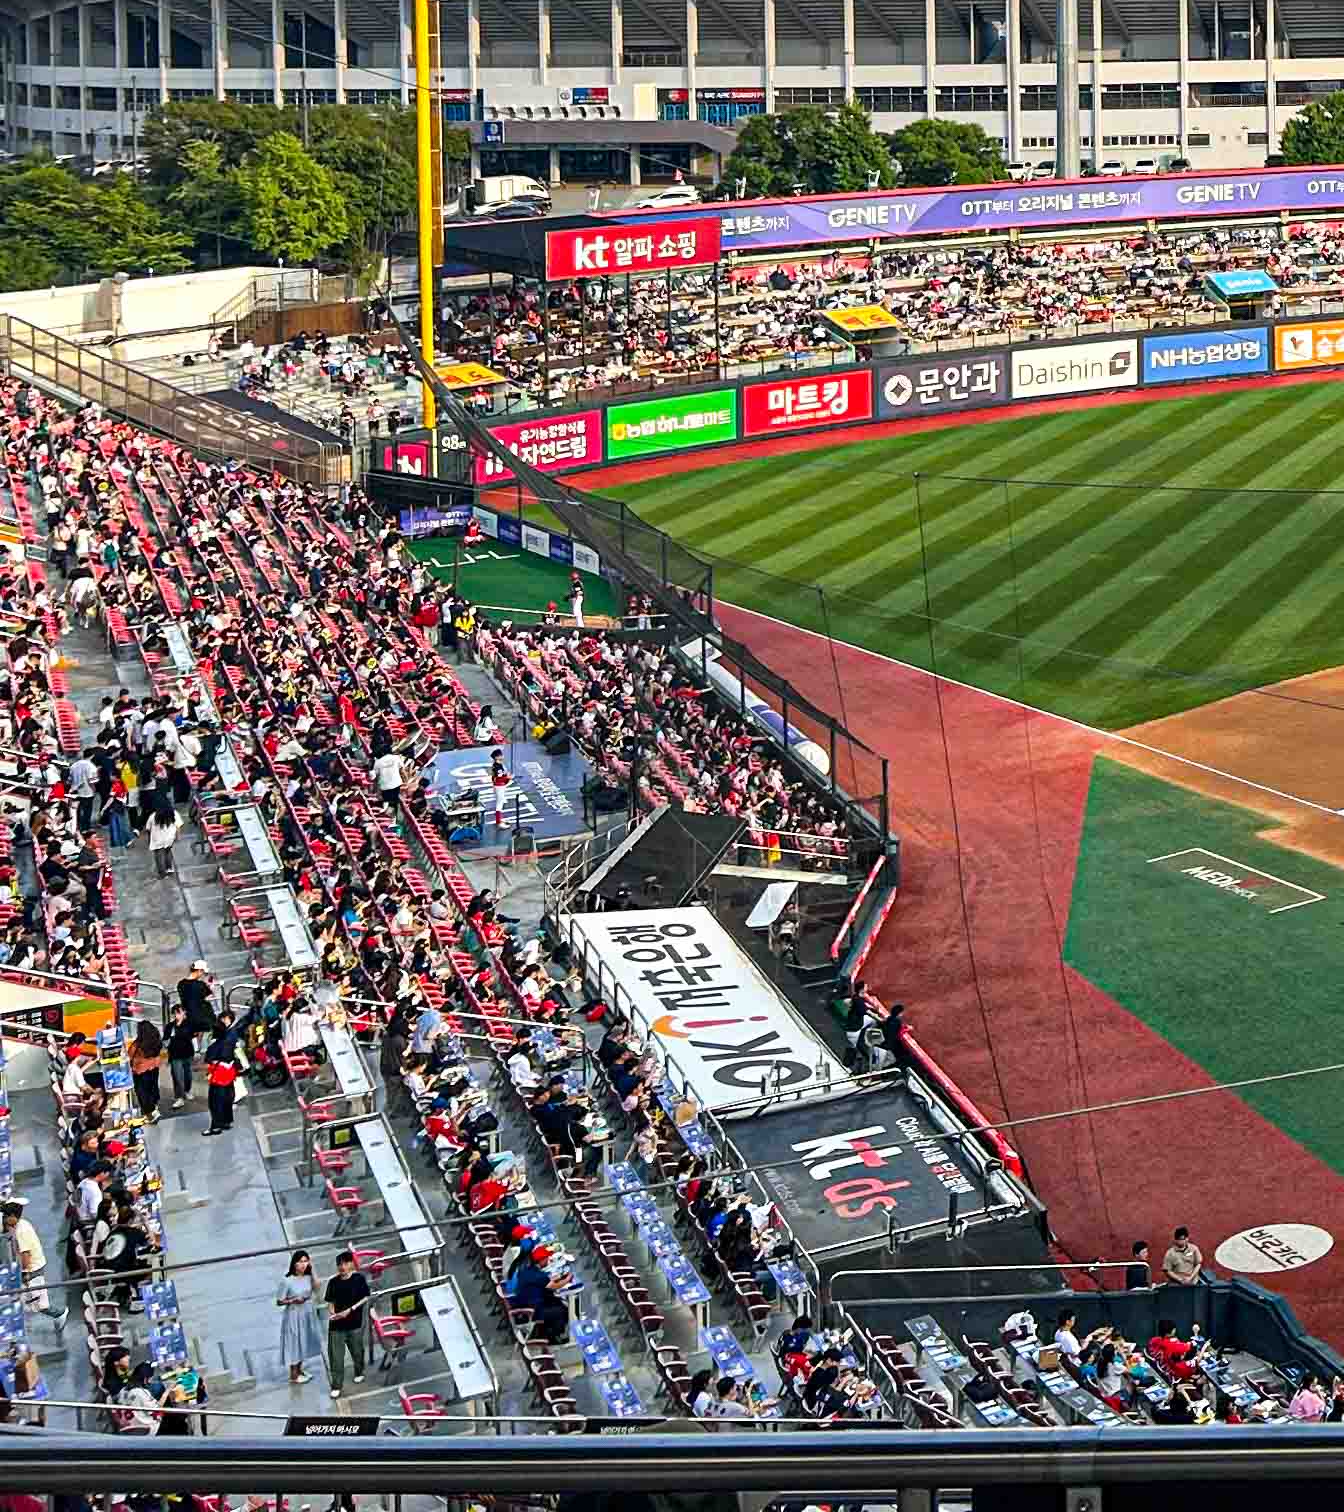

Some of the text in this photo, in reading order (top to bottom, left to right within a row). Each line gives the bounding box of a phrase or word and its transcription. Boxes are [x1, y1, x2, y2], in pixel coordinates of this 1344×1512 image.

[1017, 192, 1074, 213] 오리지널
[1176, 182, 1261, 204] GENIE TV
[828, 203, 917, 228] GENIE TV
[574, 231, 697, 269] kt 알파 쇼핑
[916, 360, 1000, 403] 문안과
[1018, 359, 1102, 387] Daishin
[768, 380, 849, 416] 마트킹
[522, 437, 587, 464] 자연드림
[793, 1124, 912, 1220] kt ds
